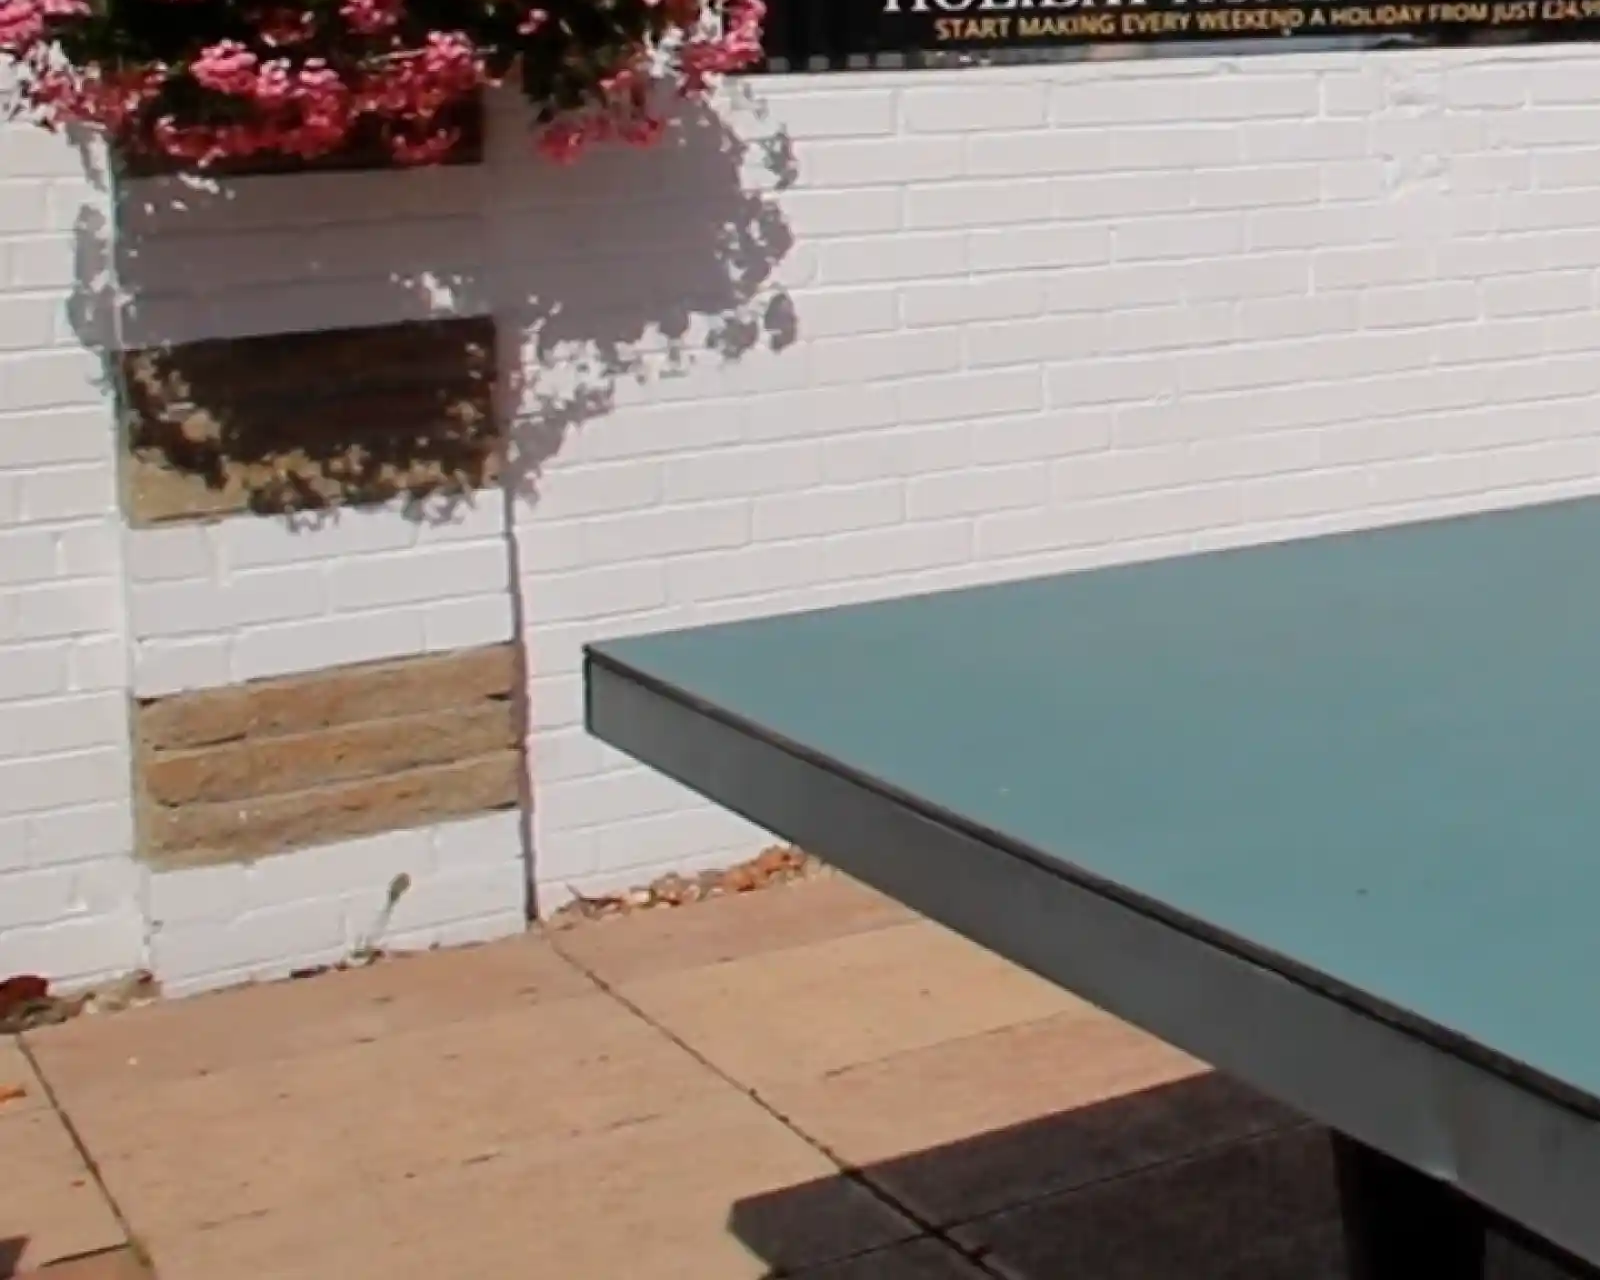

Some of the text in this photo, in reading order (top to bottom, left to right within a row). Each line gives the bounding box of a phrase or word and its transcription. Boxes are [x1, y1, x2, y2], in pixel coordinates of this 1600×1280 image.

[935, 16, 1009, 41] START
[1017, 13, 1117, 38] MAKING
[1121, 11, 1190, 33] EVERY
[1196, 7, 1305, 32] WEEKEND
[1309, 9, 1328, 27] A
[1331, 3, 1426, 27] HOLIDAY
[1428, 1, 1487, 23] FROM
[1491, 0, 1538, 21] JUST
